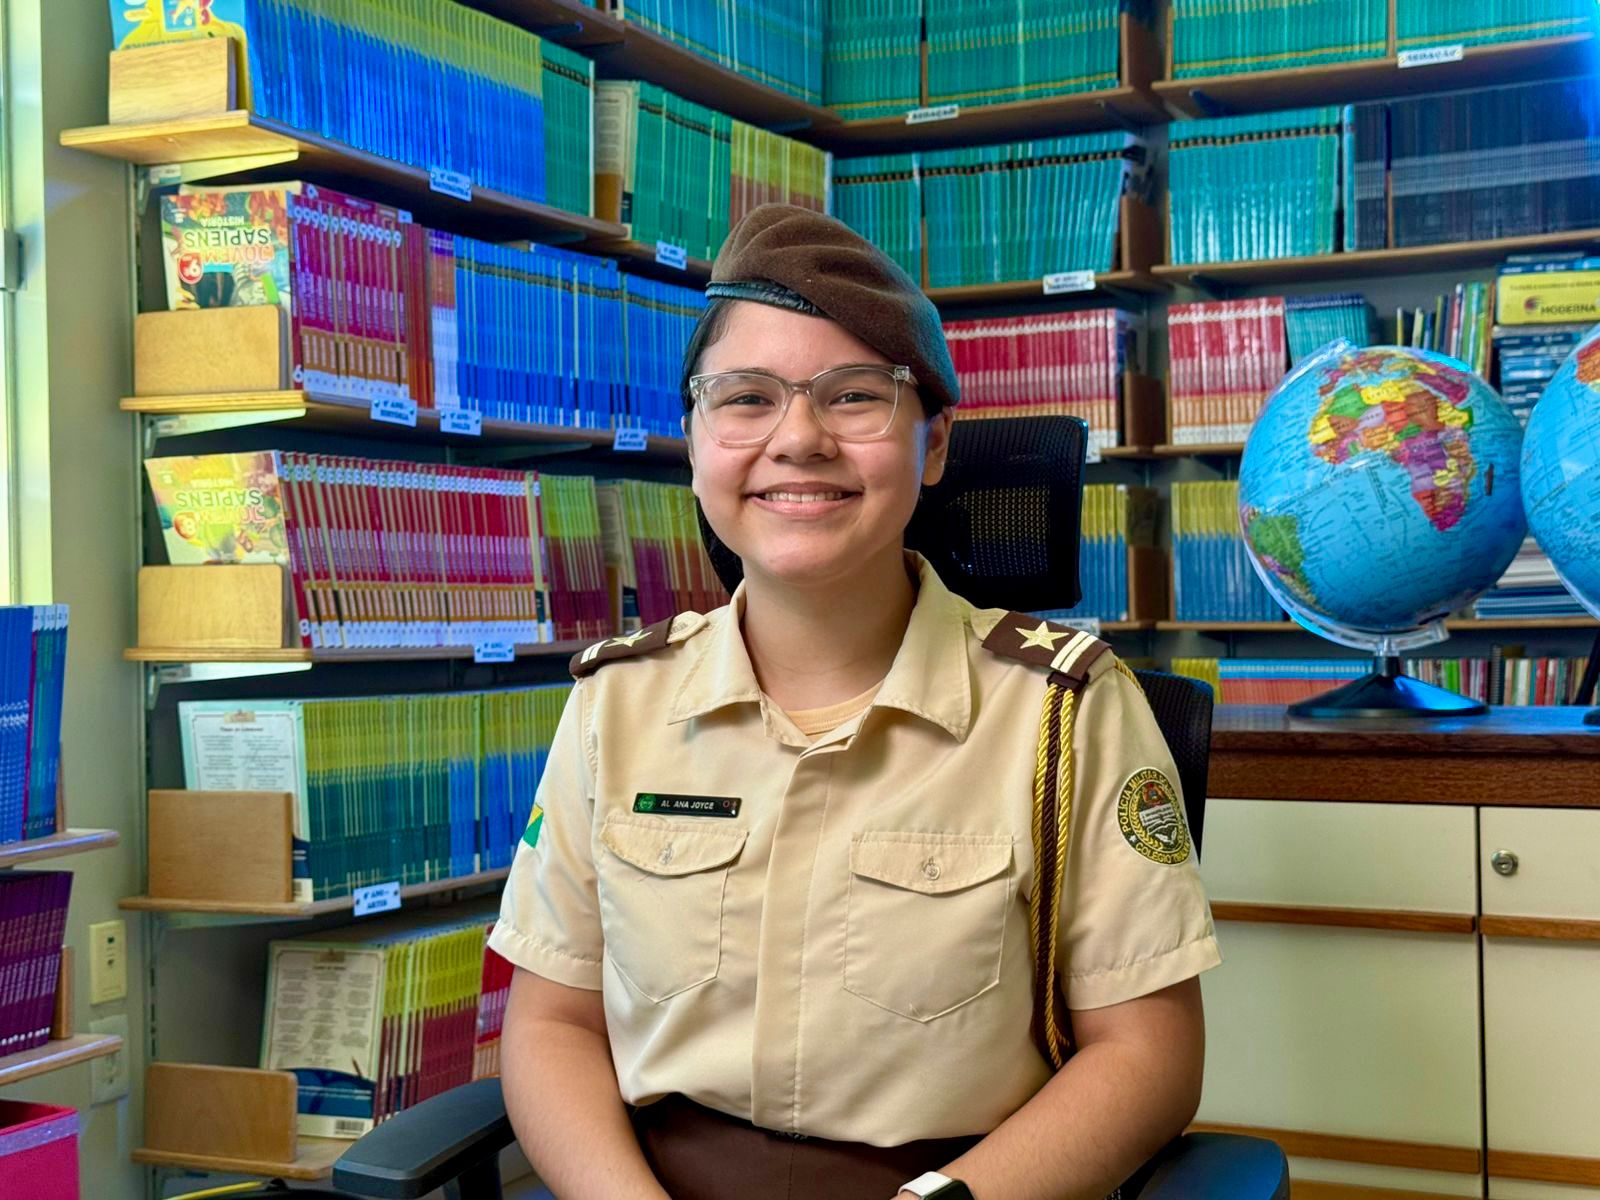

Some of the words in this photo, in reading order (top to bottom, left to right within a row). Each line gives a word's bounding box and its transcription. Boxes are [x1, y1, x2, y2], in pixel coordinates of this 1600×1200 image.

[184, 228, 271, 248] SAPIENS
[203, 245, 274, 263] JOVEM
[1540, 304, 1597, 315] MODERNA
[175, 489, 261, 507] SAPIENS
[300, 619, 310, 636] 8
[661, 800, 671, 808] AL
[673, 800, 690, 809] ANA
[690, 801, 715, 810] JOYCE
